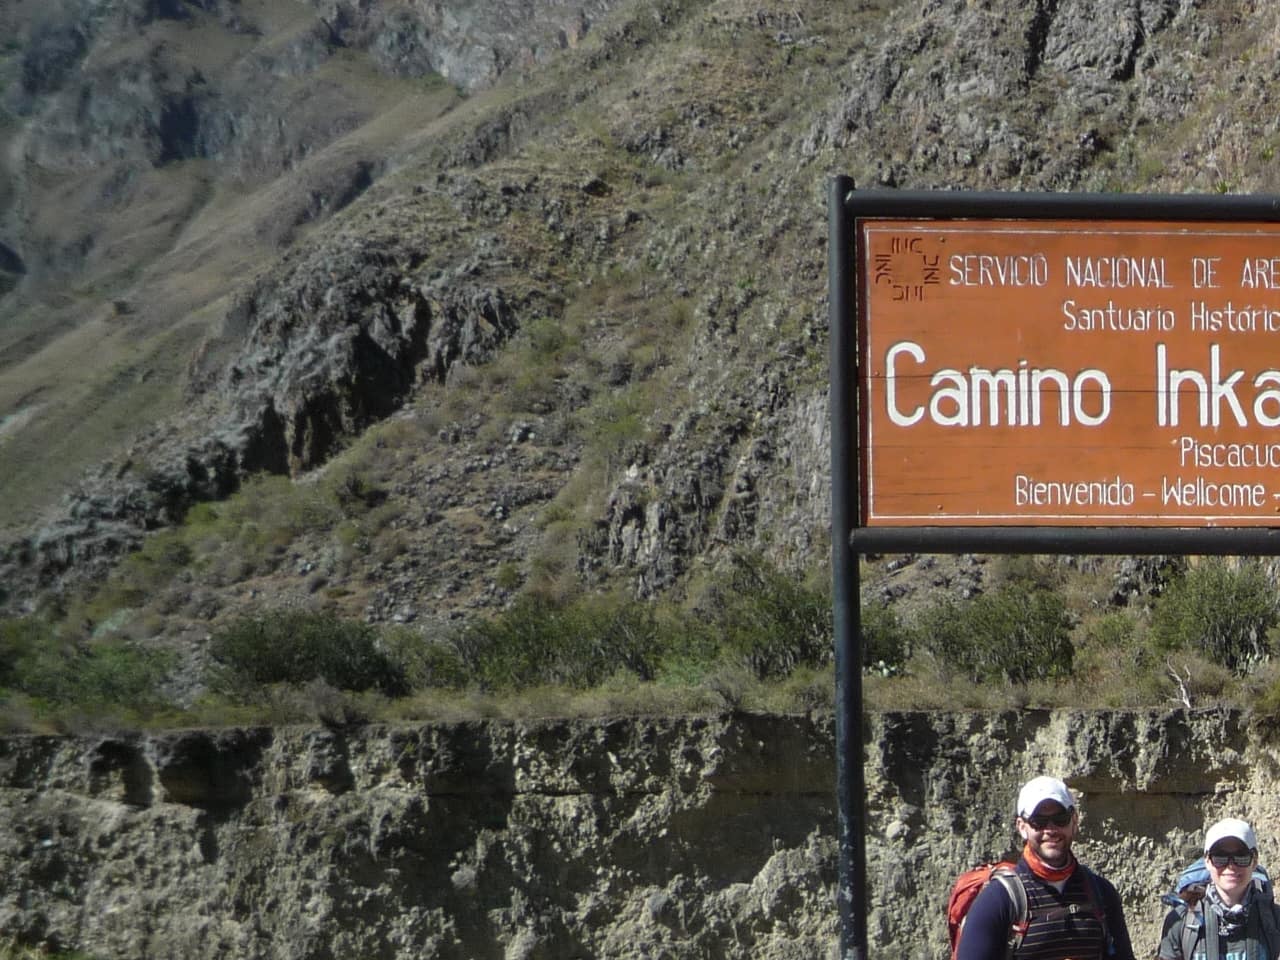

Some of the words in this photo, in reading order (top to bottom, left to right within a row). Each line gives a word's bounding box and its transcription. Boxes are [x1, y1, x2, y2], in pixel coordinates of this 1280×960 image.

[949, 255, 1048, 287] SERVICIO
[1066, 256, 1173, 289] NACIONAL
[1193, 257, 1220, 289] DE
[1063, 300, 1175, 332] Santuario
[886, 341, 1112, 427] Camino
[1015, 475, 1135, 507] Bienvenido
[1161, 476, 1266, 507] Wellcome
